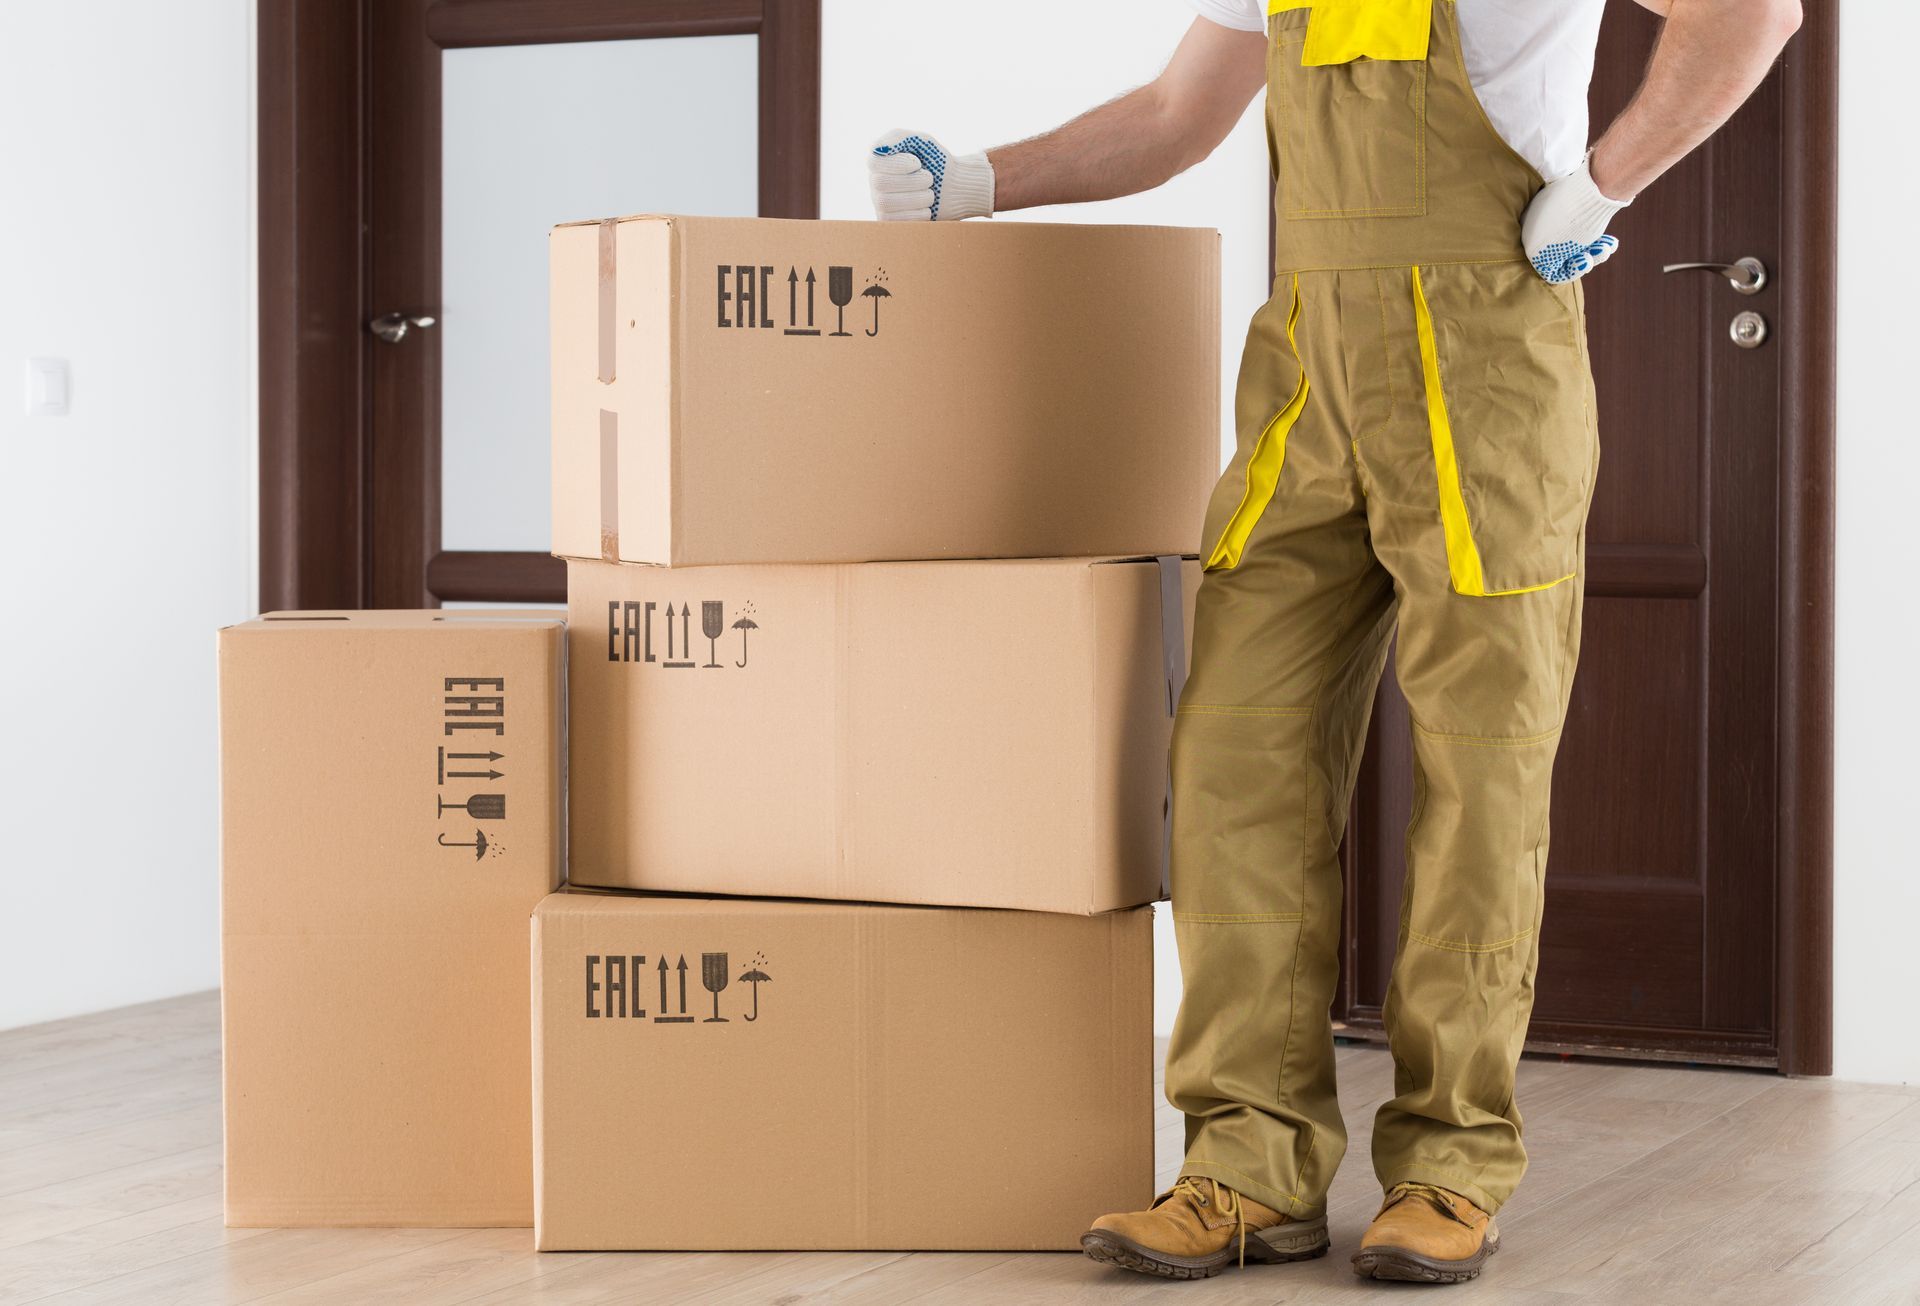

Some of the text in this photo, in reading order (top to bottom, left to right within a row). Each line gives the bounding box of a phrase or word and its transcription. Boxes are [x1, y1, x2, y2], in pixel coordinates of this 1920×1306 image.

[718, 265, 774, 328] EAC
[609, 601, 655, 662] EAC
[444, 677, 504, 736] EAC
[586, 955, 646, 1018] EAC
